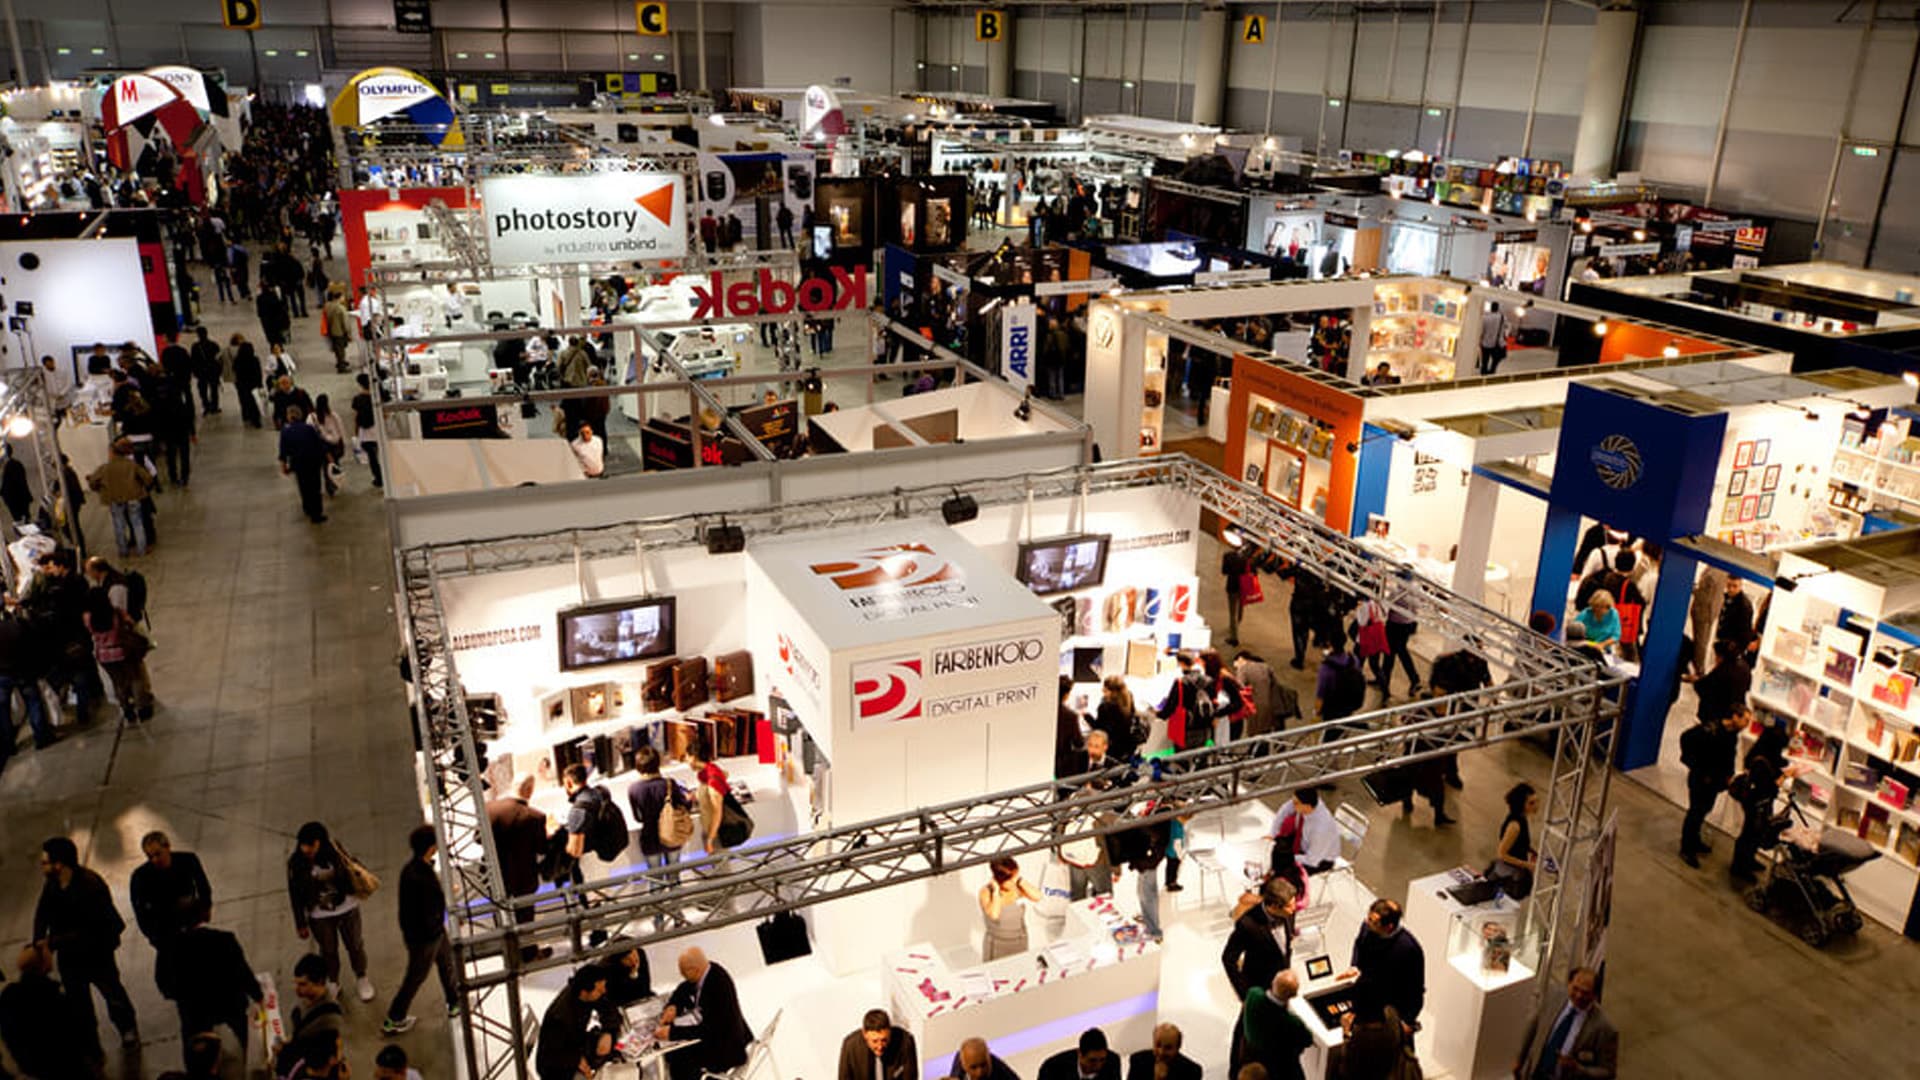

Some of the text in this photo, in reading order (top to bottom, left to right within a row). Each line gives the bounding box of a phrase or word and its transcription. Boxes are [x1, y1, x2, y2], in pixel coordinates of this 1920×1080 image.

[226, 0, 257, 26] D
[641, 4, 662, 33] C
[981, 13, 998, 39] B
[1246, 17, 1261, 41] A
[121, 79, 138, 102] M
[163, 72, 193, 83] ONY
[360, 84, 427, 95] OLYMPUS
[495, 207, 637, 238] photostory
[609, 238, 657, 252] unibind
[1009, 325, 1028, 379] ARRI
[436, 408, 481, 423] Kodak
[934, 639, 1044, 675] FARBENFOTO
[931, 686, 1038, 718] DIGITAL PRINT
